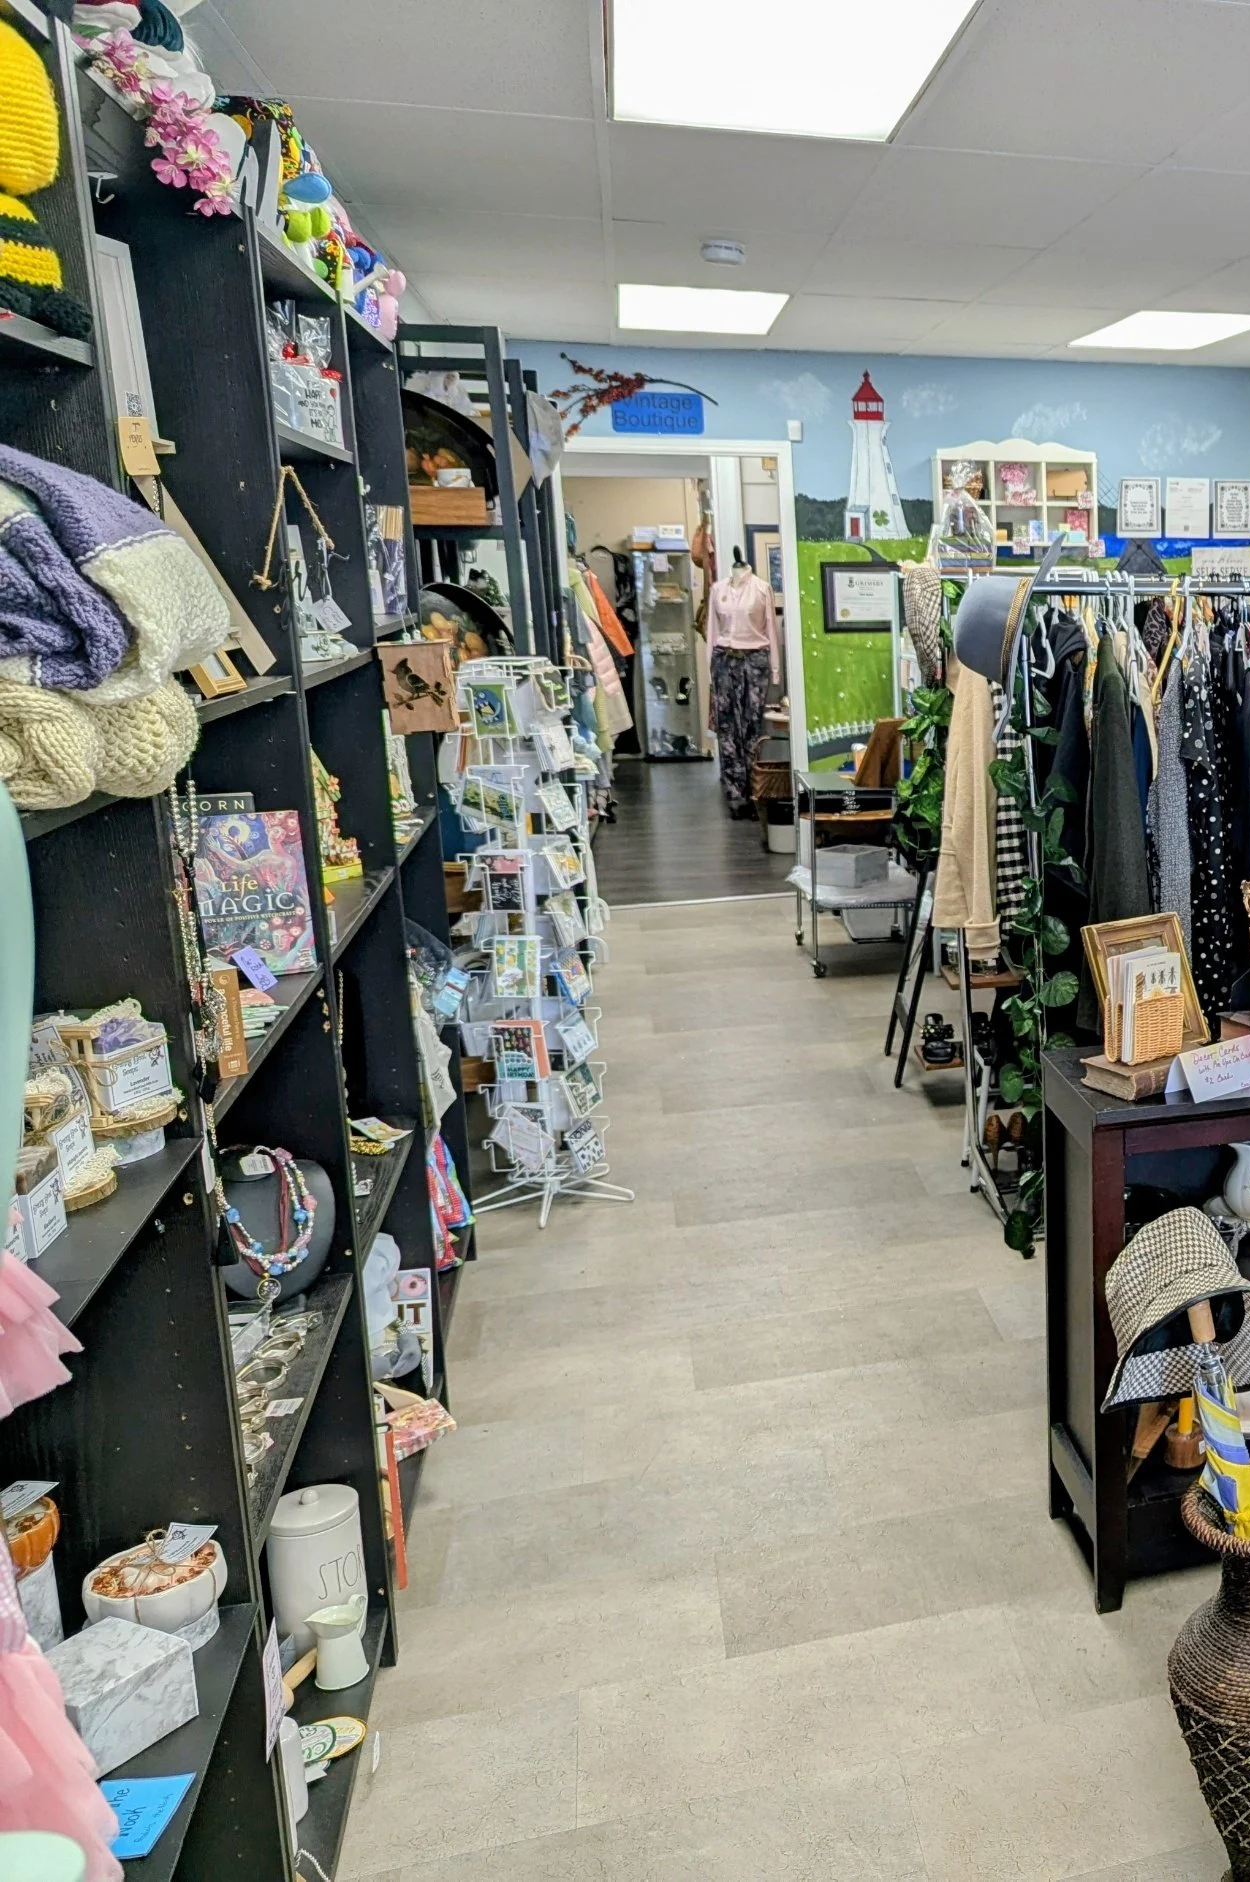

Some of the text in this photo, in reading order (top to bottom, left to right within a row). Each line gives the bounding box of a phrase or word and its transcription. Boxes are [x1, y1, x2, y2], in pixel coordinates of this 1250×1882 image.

[622, 393, 693, 413] Vintage
[614, 410, 699, 431] Boutique
[1195, 566, 1249, 577] SELF SERVE
[221, 874, 259, 901] Life
[235, 914, 260, 922] POSITIVE
[261, 910, 297, 919] WITCHCRAFT
[223, 1037, 232, 1052] life
[130, 1076, 150, 1087] Lavender
